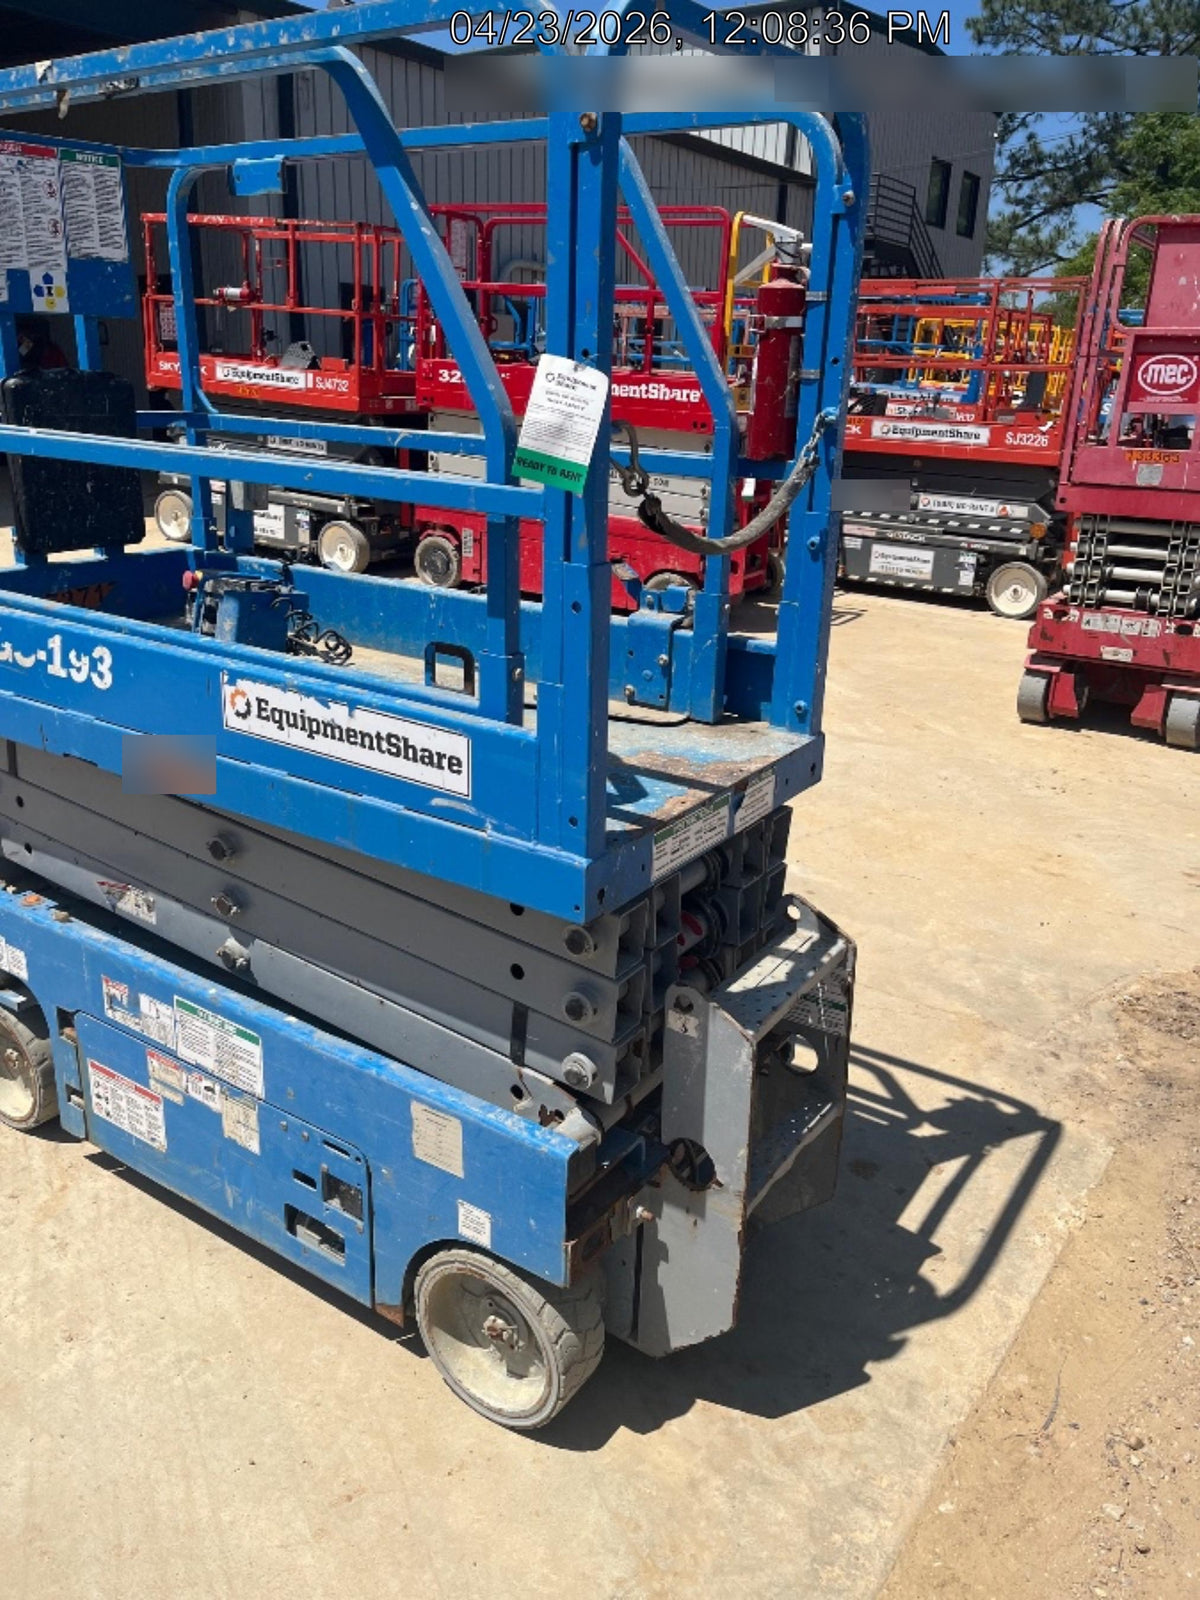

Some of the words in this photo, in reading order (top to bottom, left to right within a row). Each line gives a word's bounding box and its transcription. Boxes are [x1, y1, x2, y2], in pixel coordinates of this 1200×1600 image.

[315, 376, 349, 392] SJ4732
[1005, 431, 1049, 448] SJ3226
[515, 455, 545, 473] READY
[559, 468, 583, 483] RENT
[255, 696, 464, 776] EquipmentShare
